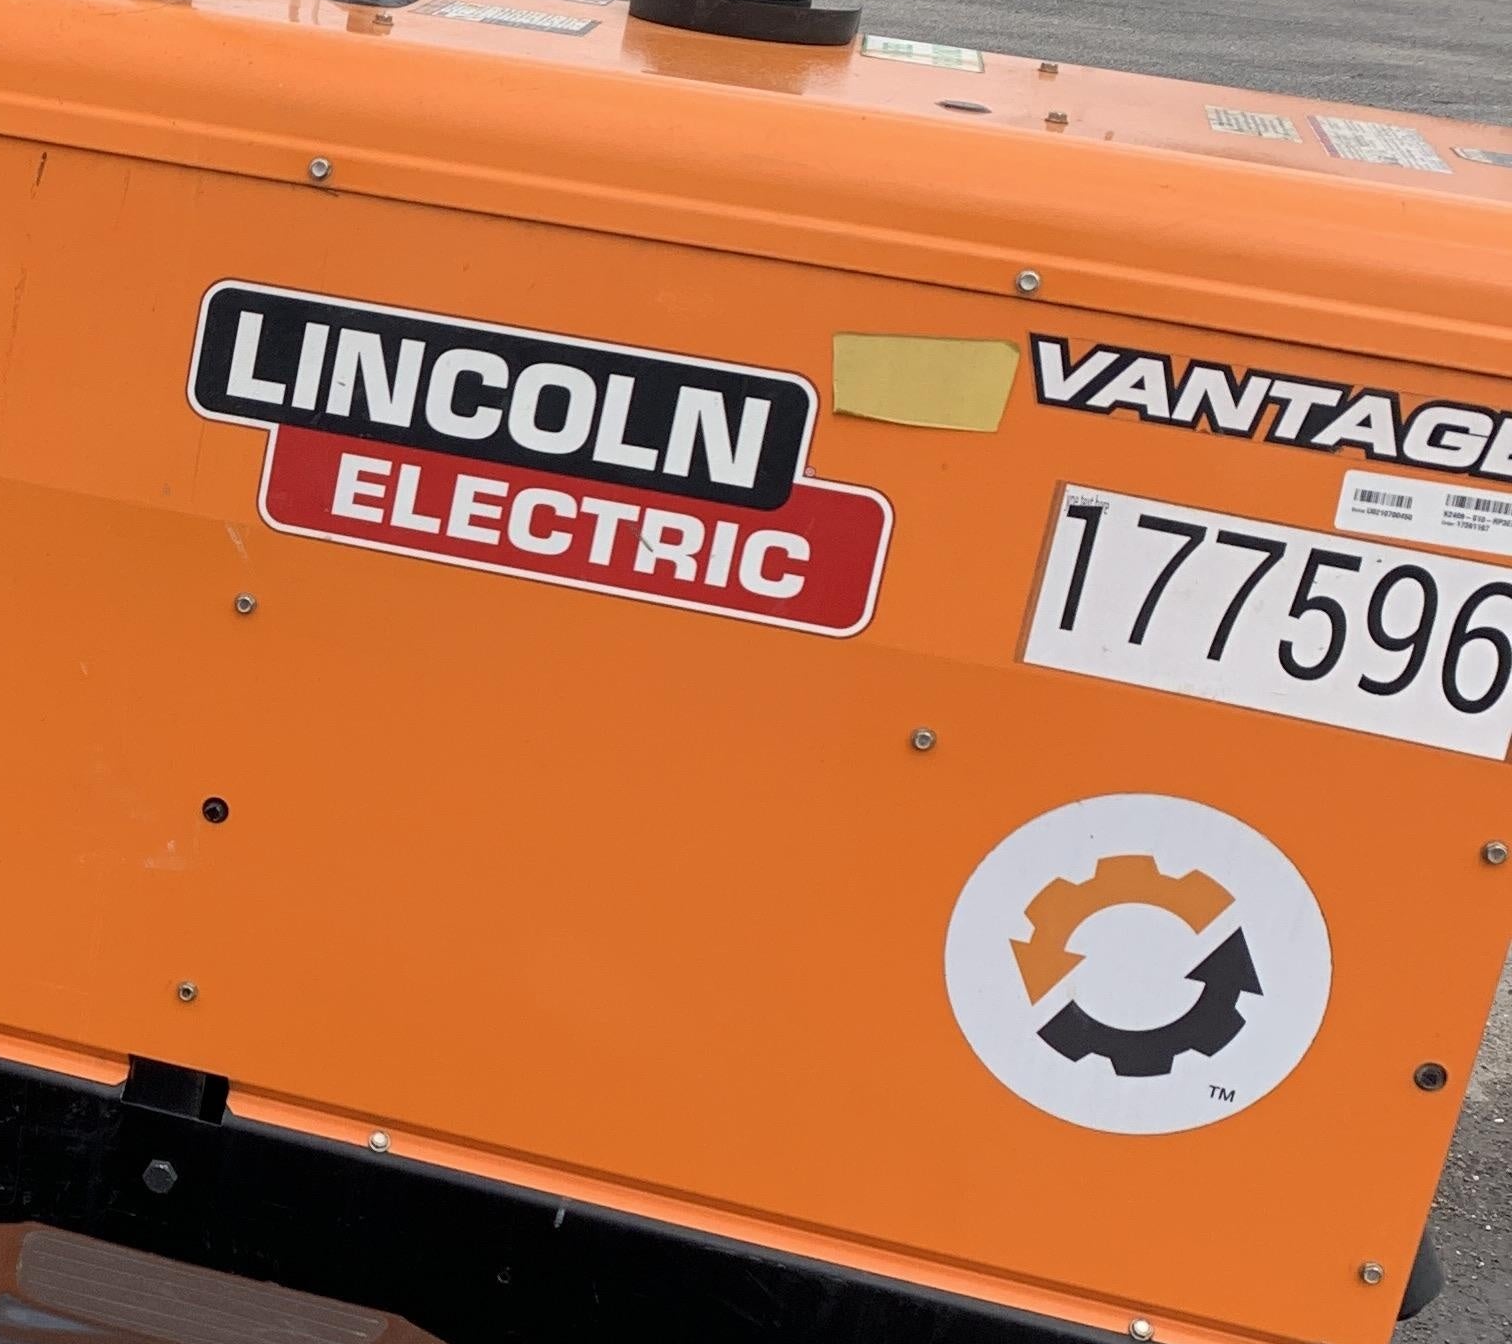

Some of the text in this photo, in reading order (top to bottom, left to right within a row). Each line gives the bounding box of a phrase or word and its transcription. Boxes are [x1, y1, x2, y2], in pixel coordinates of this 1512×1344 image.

[225, 310, 772, 491] LINCOLN
[330, 451, 812, 600] ELECTRIC
[1059, 505, 1512, 715] 177596
[1208, 1084, 1236, 1103] TM
